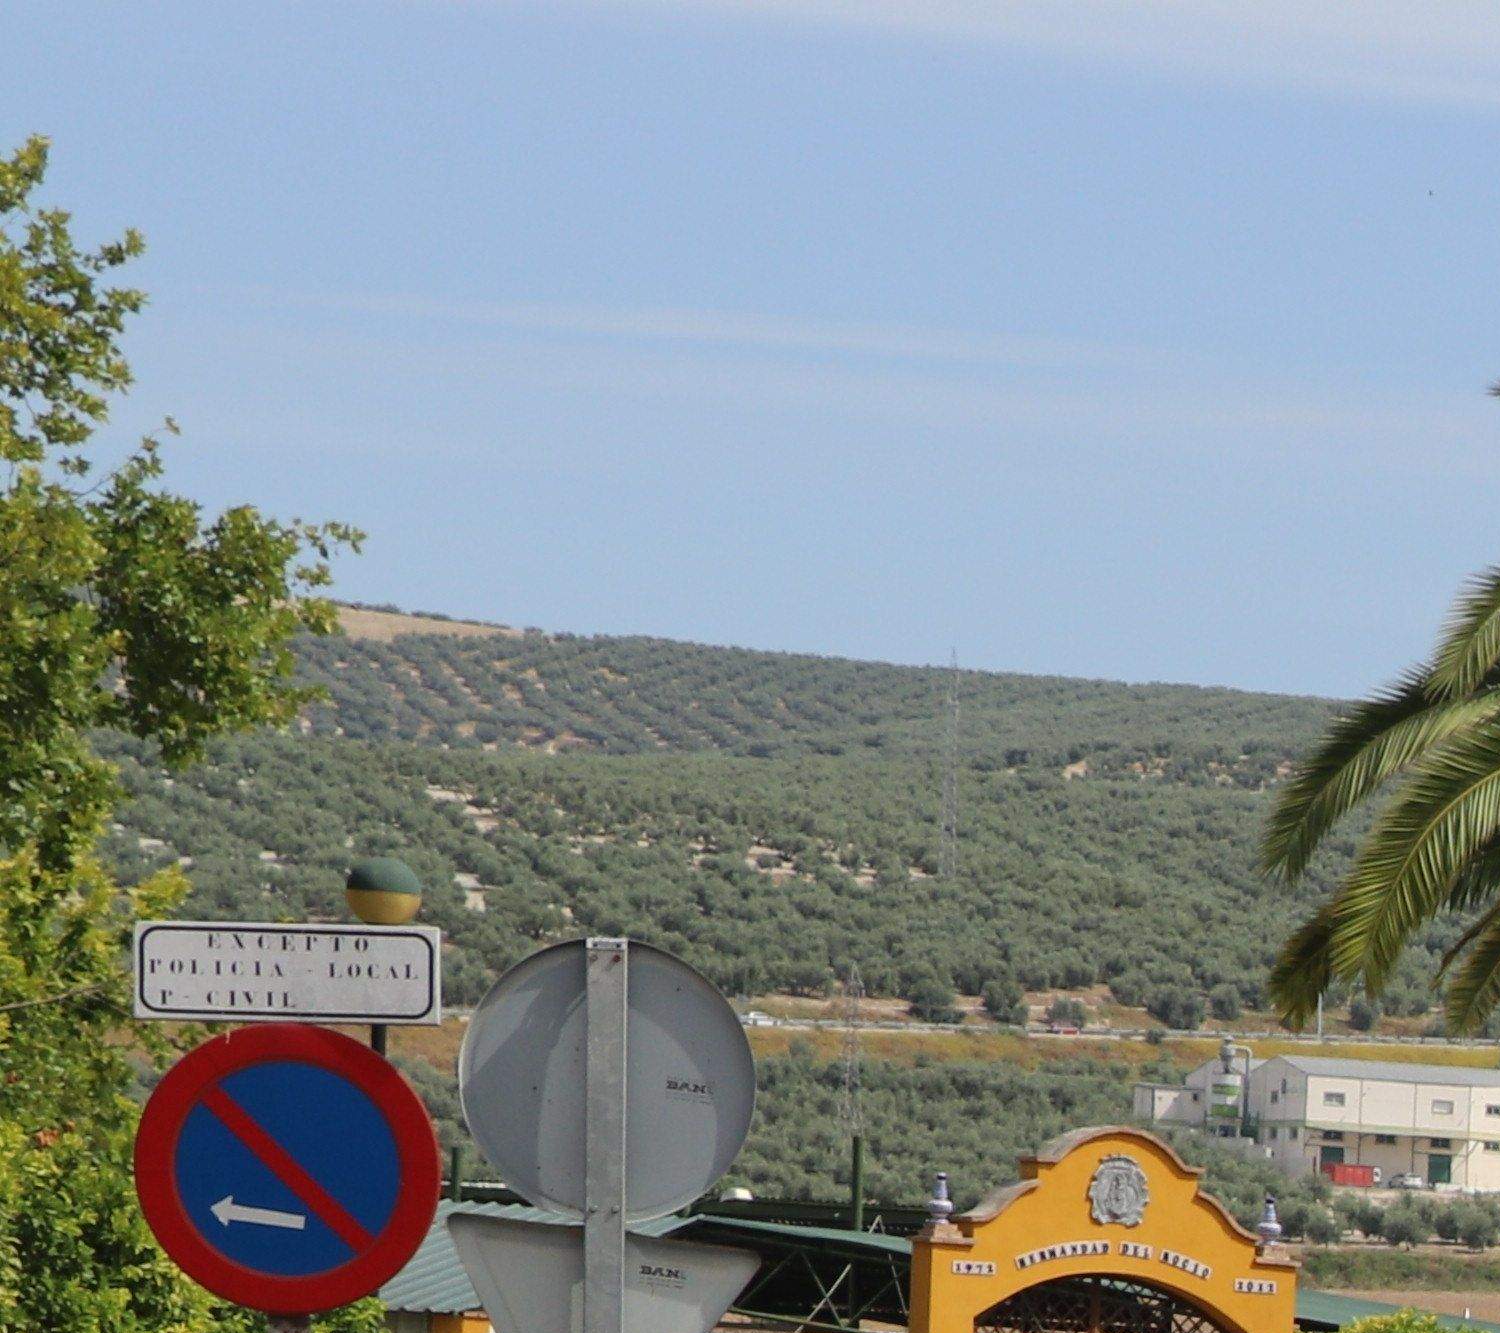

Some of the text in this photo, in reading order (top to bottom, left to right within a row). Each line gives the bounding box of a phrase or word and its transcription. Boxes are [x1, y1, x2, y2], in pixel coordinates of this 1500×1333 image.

[206, 932, 370, 952] EXCEPTO
[149, 957, 284, 977] POLICIA
[327, 961, 420, 980] LOCAL
[206, 990, 297, 1008] CIVIL
[1121, 1243, 1151, 1259] DEL
